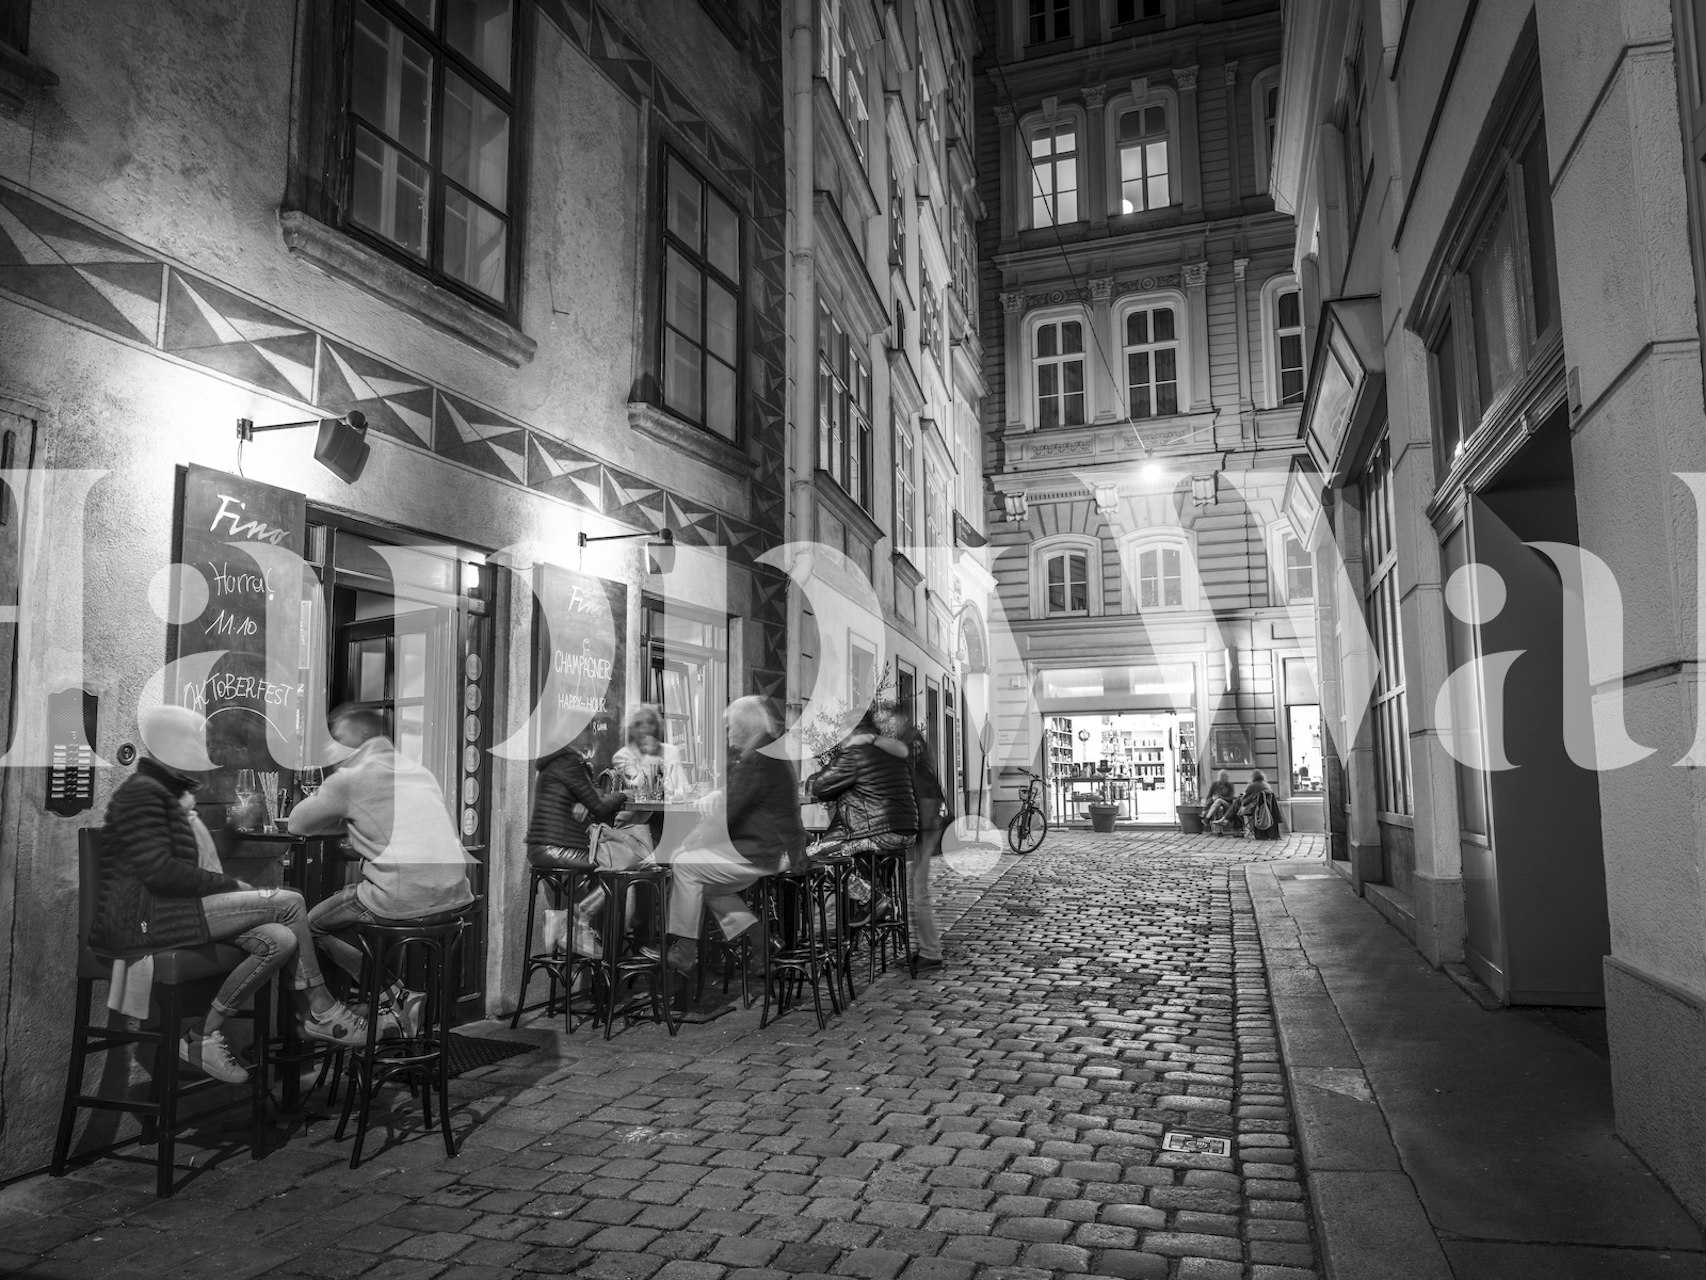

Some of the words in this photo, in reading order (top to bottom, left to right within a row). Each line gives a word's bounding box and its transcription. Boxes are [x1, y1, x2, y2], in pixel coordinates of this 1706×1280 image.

[209, 494, 290, 545] Fino
[208, 561, 276, 601] Hurra!
[554, 649, 612, 681] CHAMPAGNER
[183, 672, 294, 716] OKTOBERFEST
